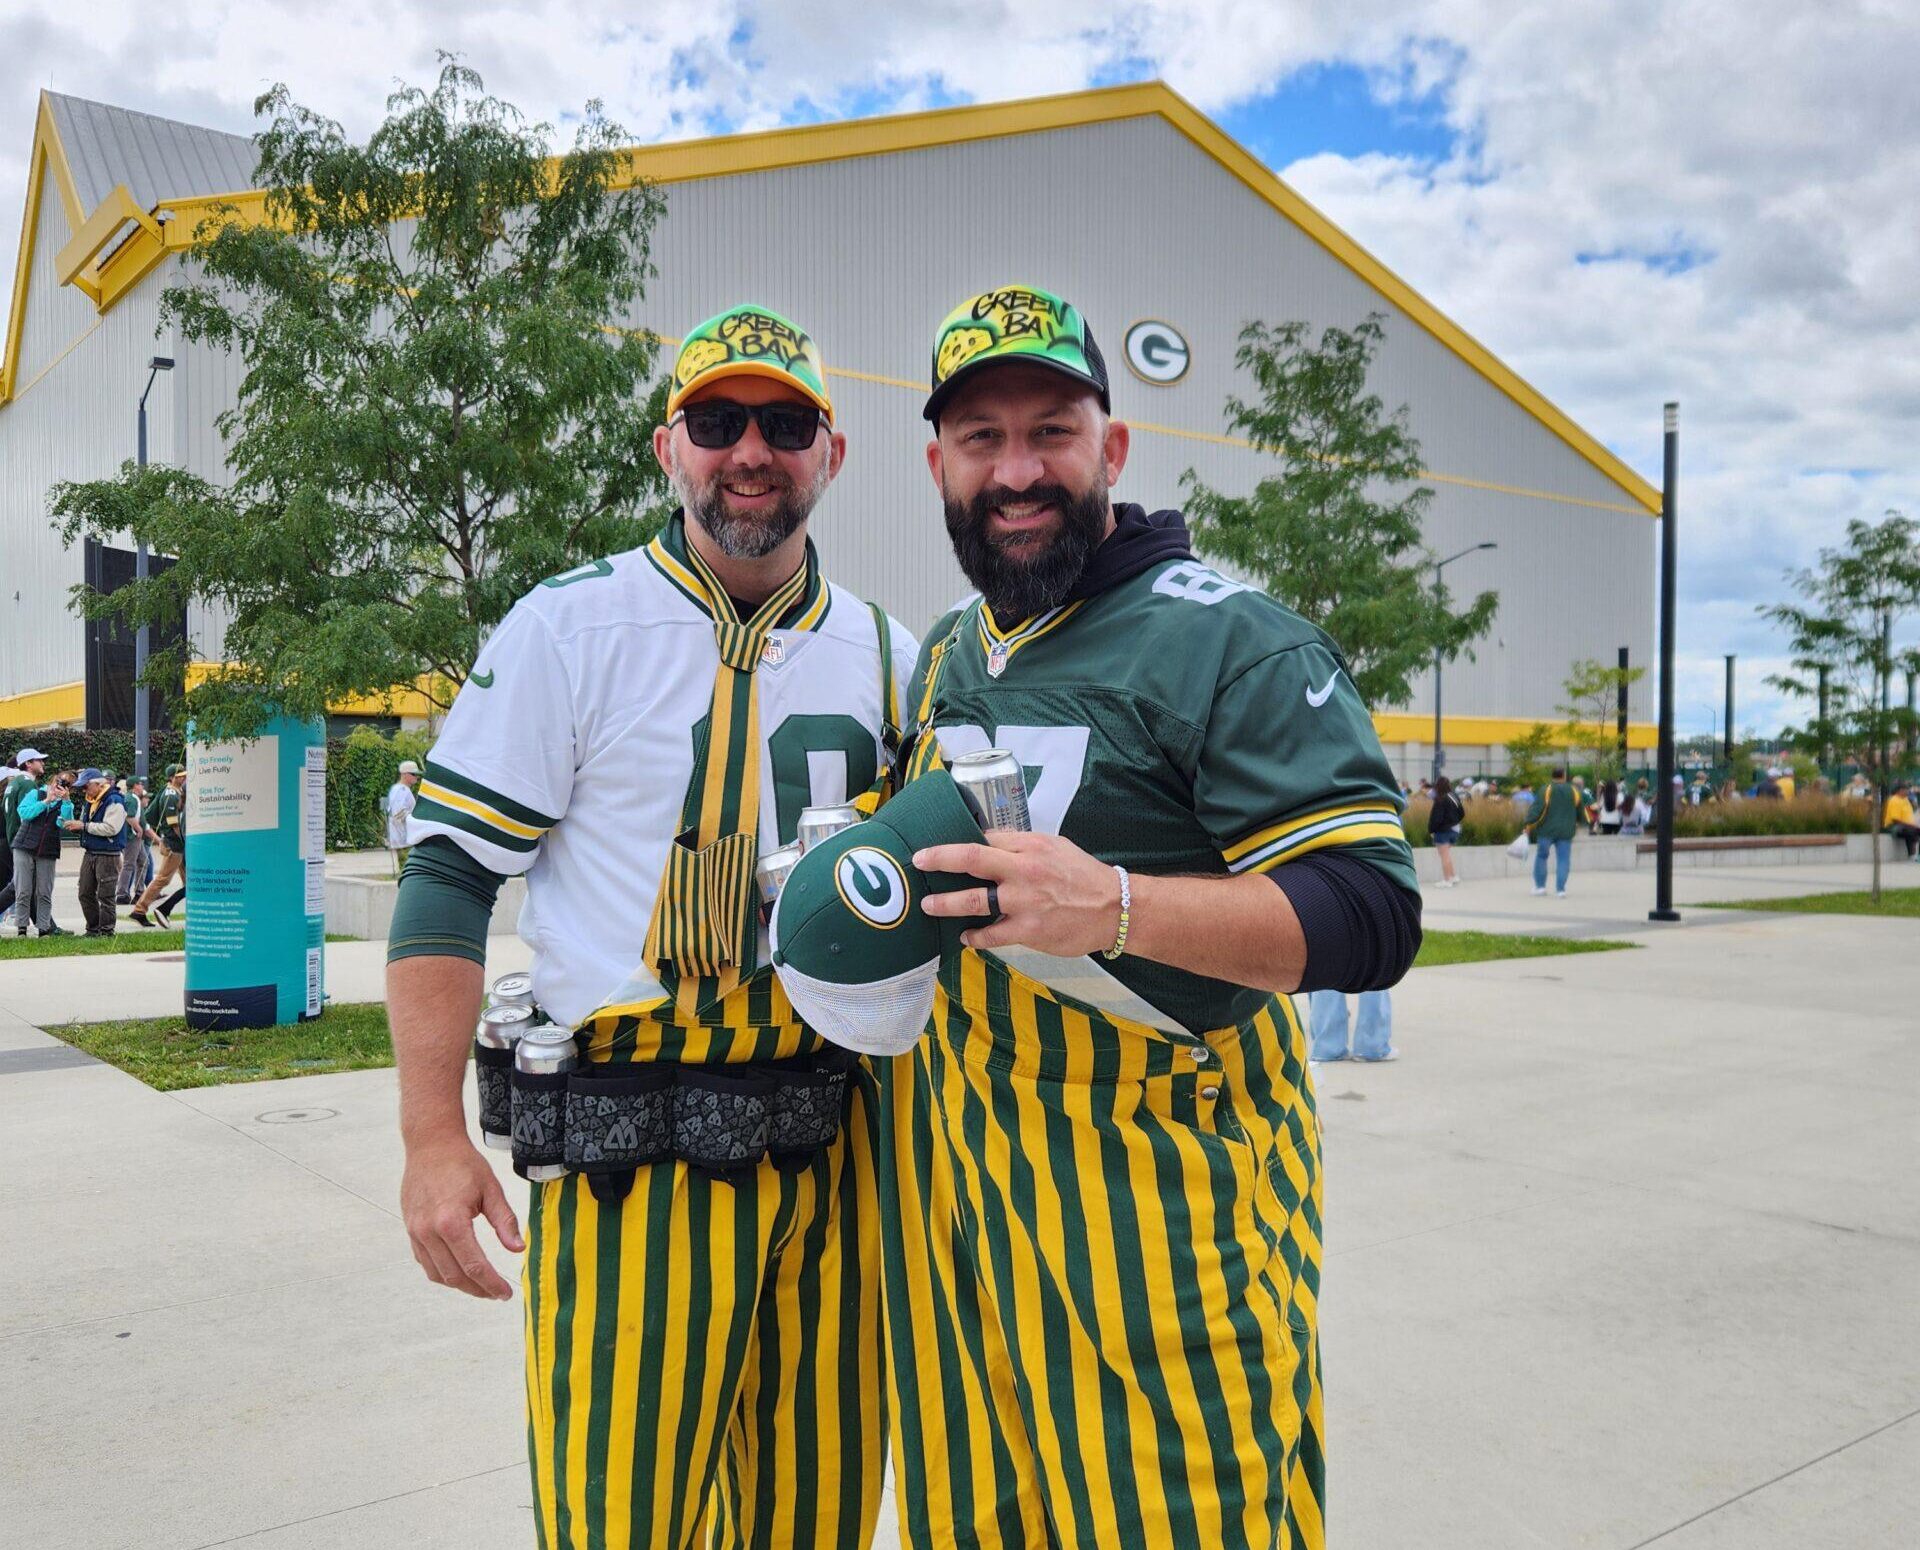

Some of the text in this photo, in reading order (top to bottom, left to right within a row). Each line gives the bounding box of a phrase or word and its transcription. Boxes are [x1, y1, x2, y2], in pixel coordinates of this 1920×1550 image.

[972, 290, 1072, 328] GREEN
[719, 312, 812, 353] GREEN
[998, 312, 1081, 351] BAY
[738, 334, 809, 372] BAY
[1123, 319, 1190, 385] G
[199, 793, 252, 803] Sustainability
[691, 714, 878, 849] 0
[837, 847, 908, 927] G
